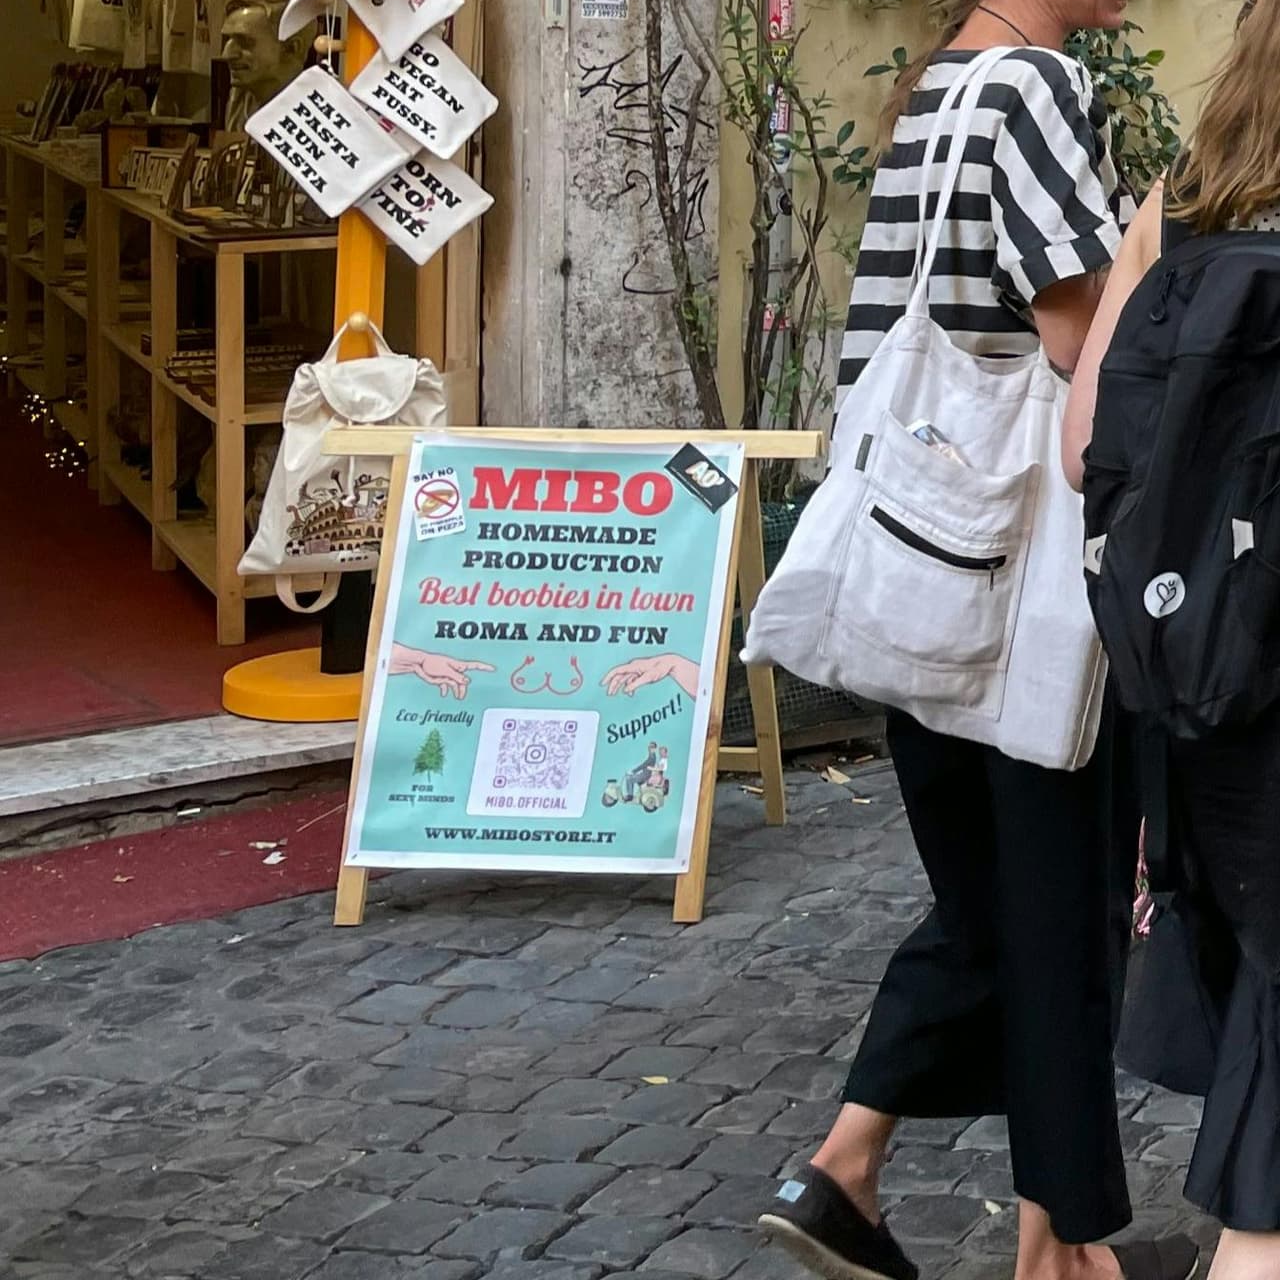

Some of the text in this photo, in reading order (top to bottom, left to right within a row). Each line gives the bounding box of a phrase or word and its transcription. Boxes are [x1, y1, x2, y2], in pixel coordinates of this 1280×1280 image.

[408, 41, 440, 68] GO
[384, 70, 425, 103] EAT
[399, 55, 465, 114] VEGAN
[307, 89, 352, 130] EAT
[372, 85, 438, 140] PUSSY.
[278, 115, 326, 161] RUN
[293, 102, 361, 169] PASTA
[263, 127, 328, 193] FASTA
[438, 466, 455, 477] NO
[468, 465, 675, 517] MIBO
[477, 521, 658, 546] HOMEMADE
[462, 549, 664, 574] PRODUCTION
[418, 576, 696, 613] Best boobies in town
[434, 619, 669, 645] ROMA AND FUN
[606, 692, 684, 745] Support!
[484, 795, 569, 810] MIBO.OFFICIAL
[424, 827, 617, 844] WWW.MIBOSTORE.IT
